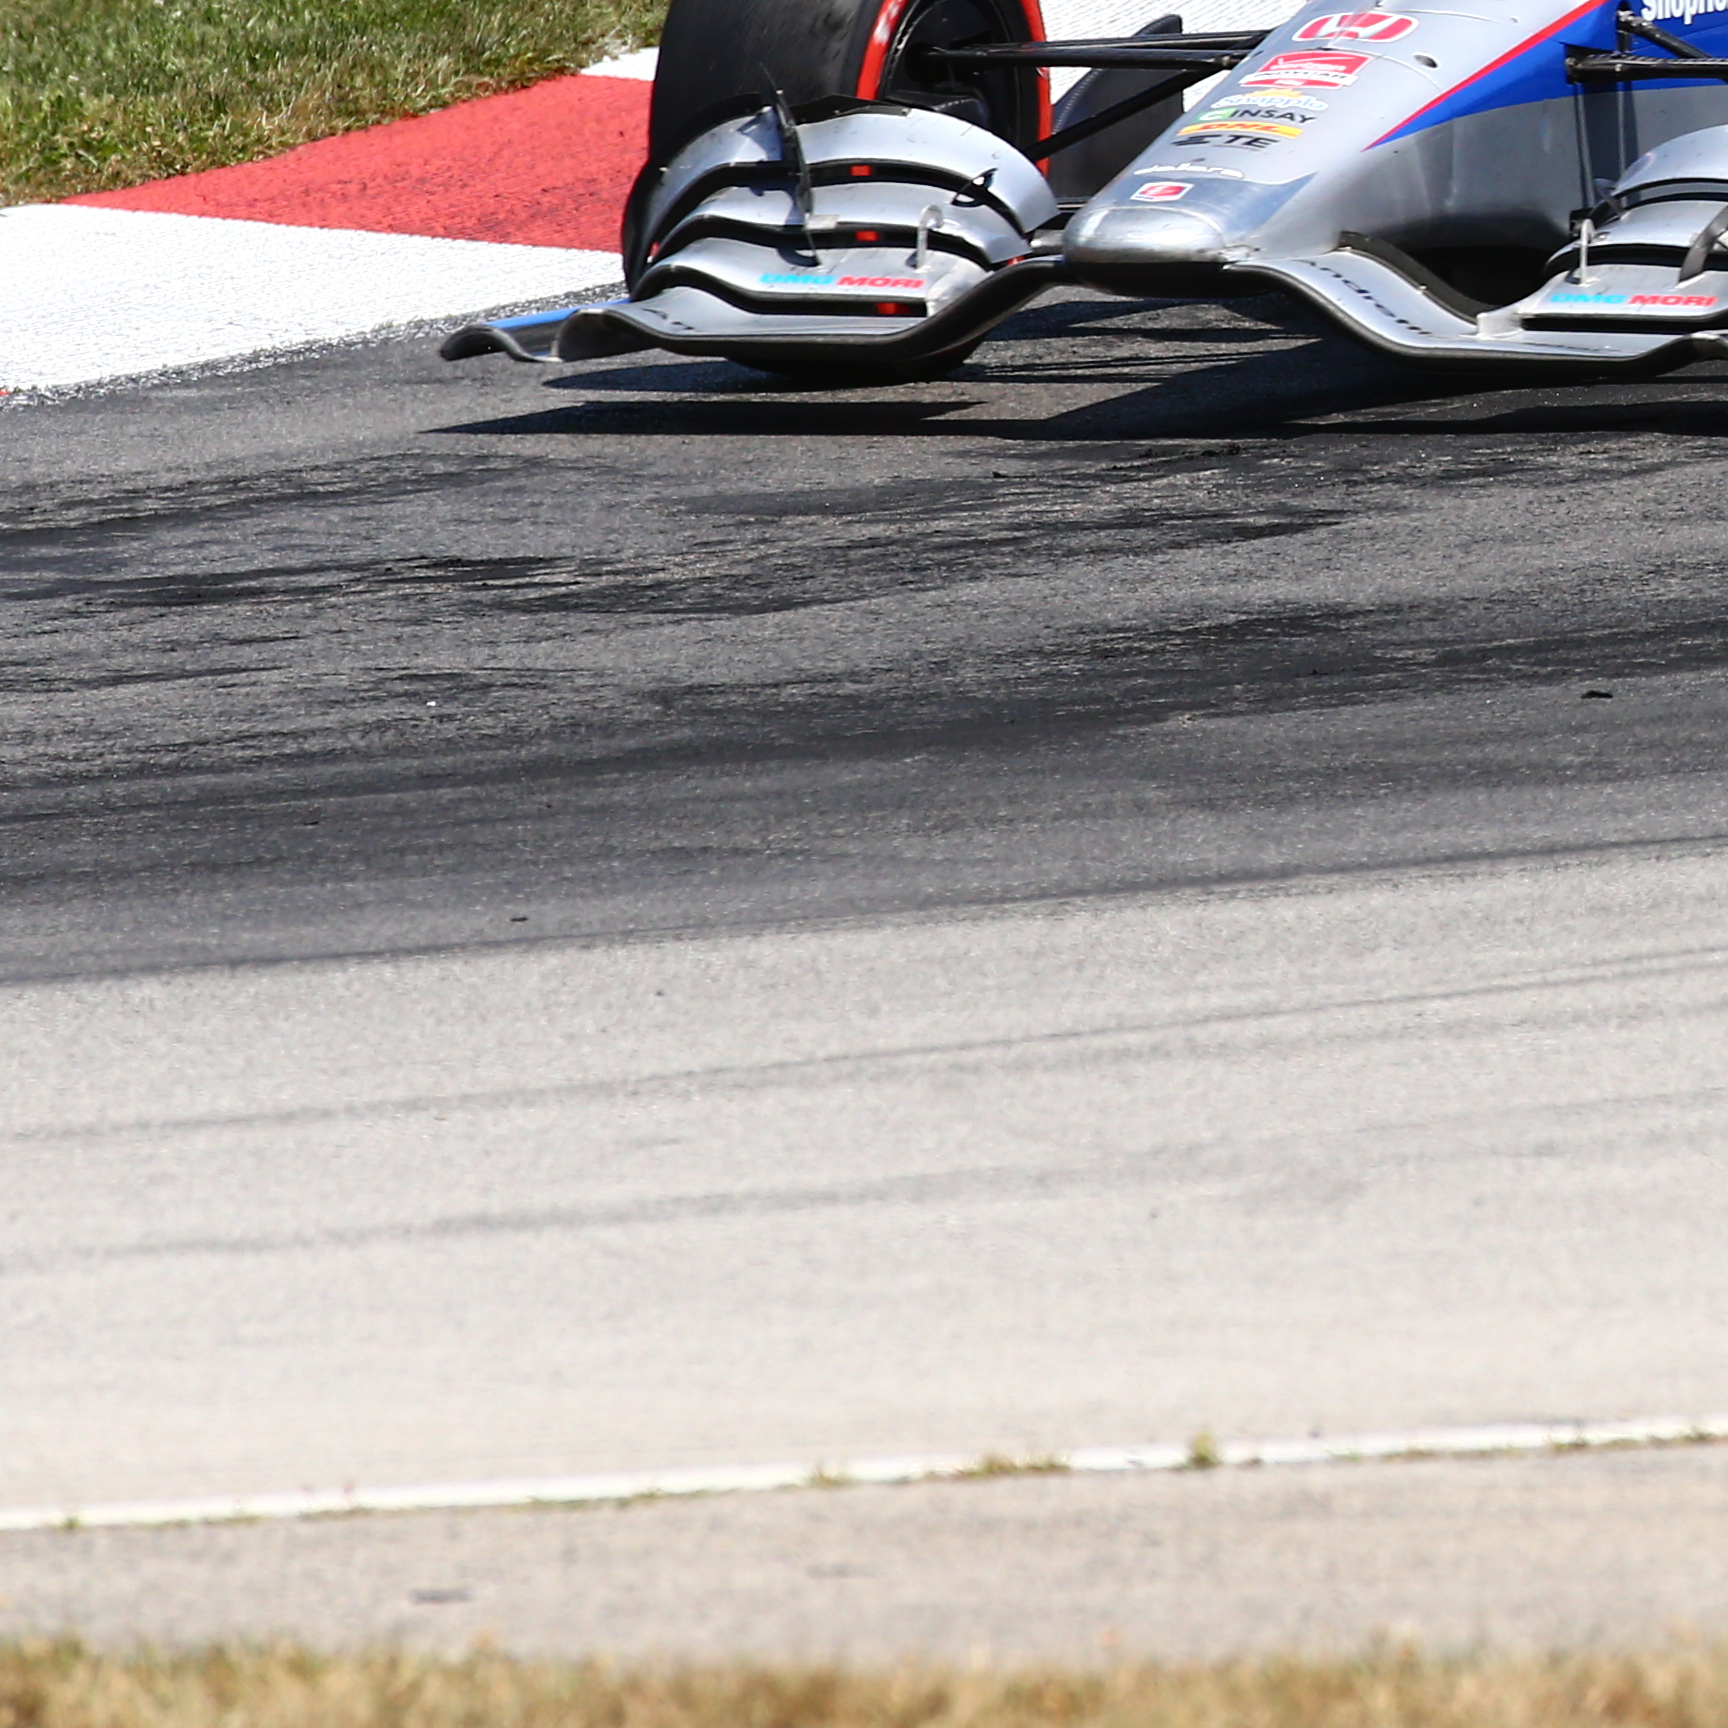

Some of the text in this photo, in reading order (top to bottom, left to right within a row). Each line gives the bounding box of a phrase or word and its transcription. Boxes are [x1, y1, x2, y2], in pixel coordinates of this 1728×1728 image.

[759, 273, 926, 289] DMG MORI
[1550, 292, 1718, 307] DMG MORI
